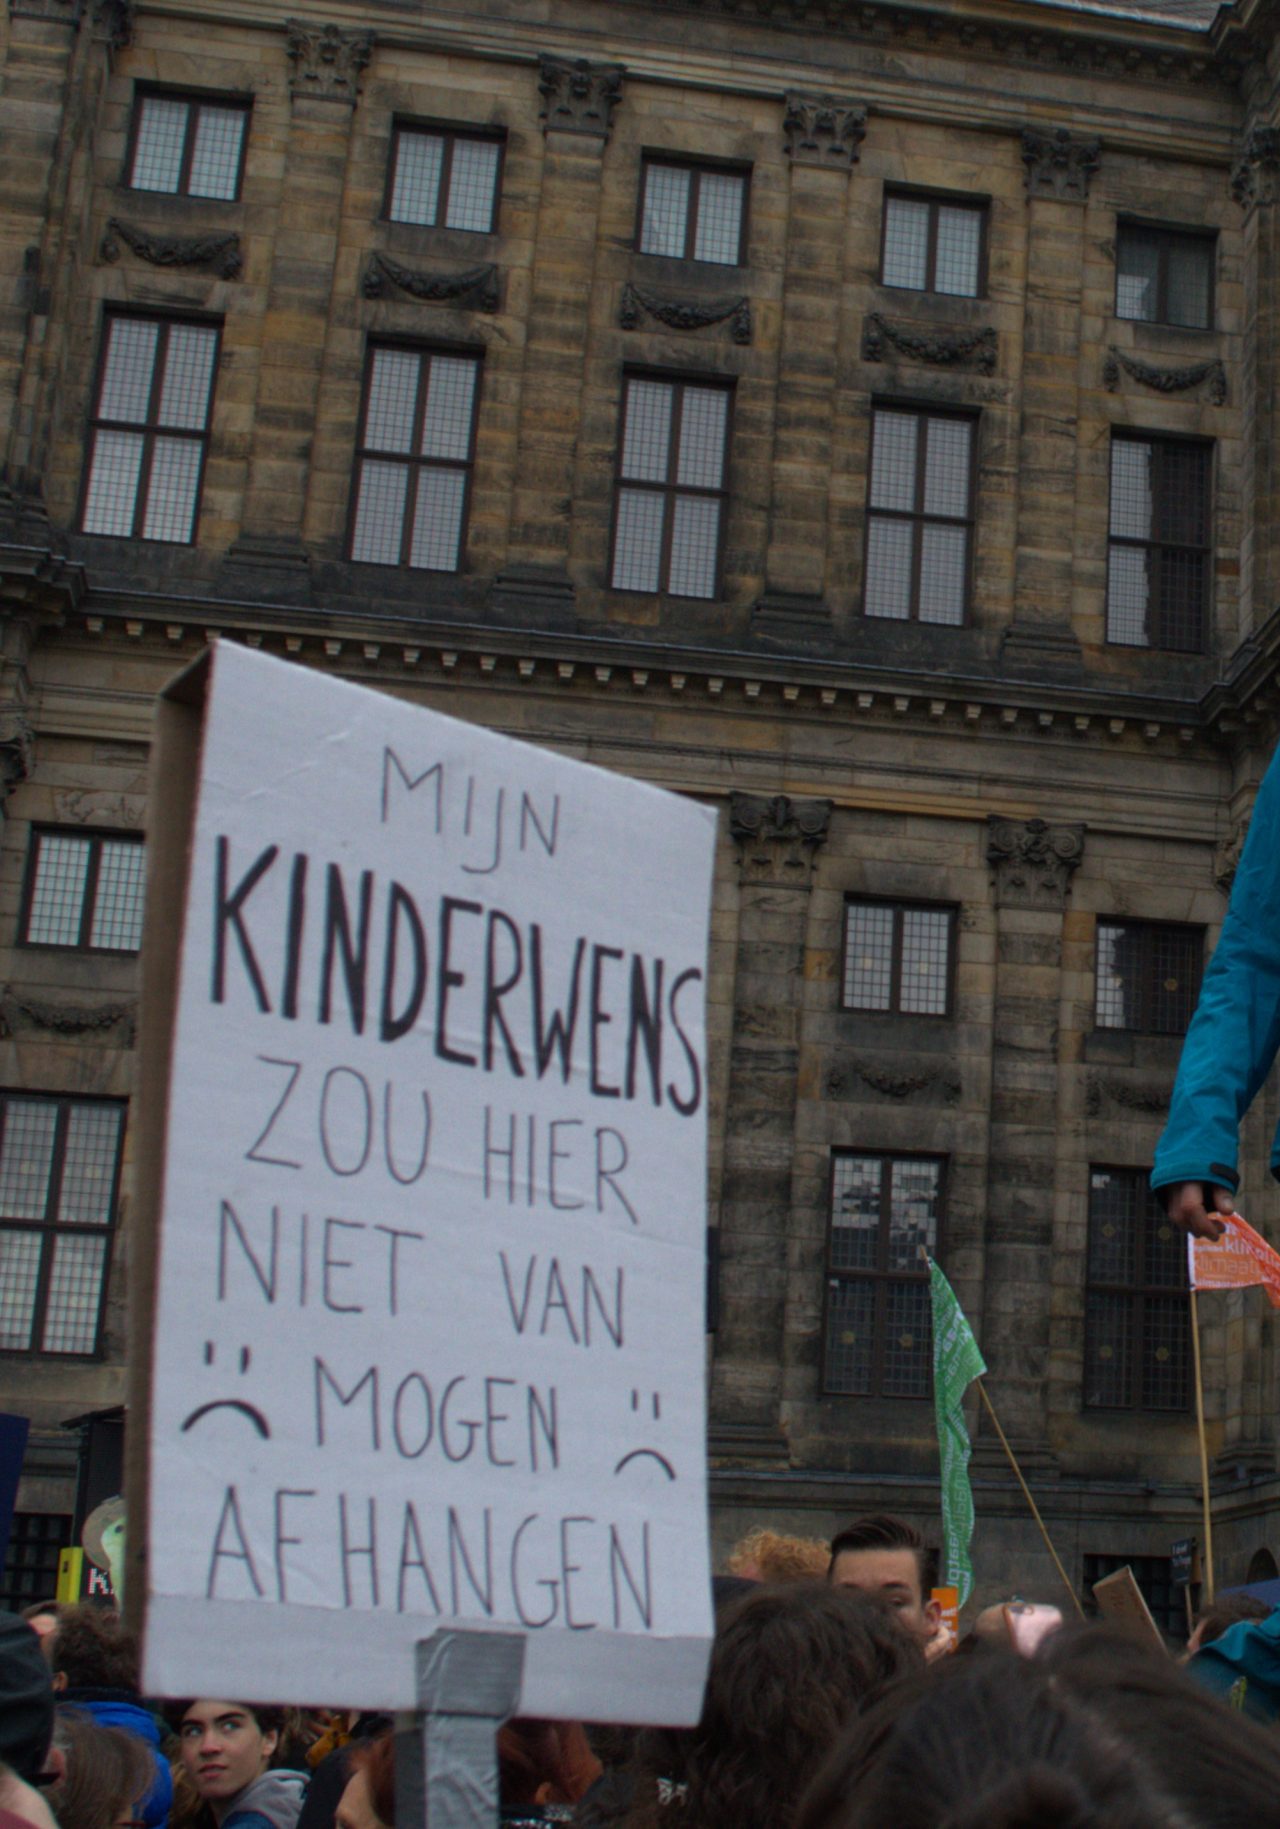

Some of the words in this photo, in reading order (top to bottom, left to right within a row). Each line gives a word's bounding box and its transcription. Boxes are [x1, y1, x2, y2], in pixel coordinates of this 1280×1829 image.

[380, 745, 560, 874] MIJN
[210, 835, 702, 1117] KINDERWENS
[244, 1054, 432, 1186] ZOU
[483, 1104, 638, 1226] HIER
[217, 1199, 425, 1317] NIET
[499, 1251, 625, 1349] VAN
[313, 1355, 560, 1473] MOGEN
[205, 1484, 654, 1631] AFHANGEN
